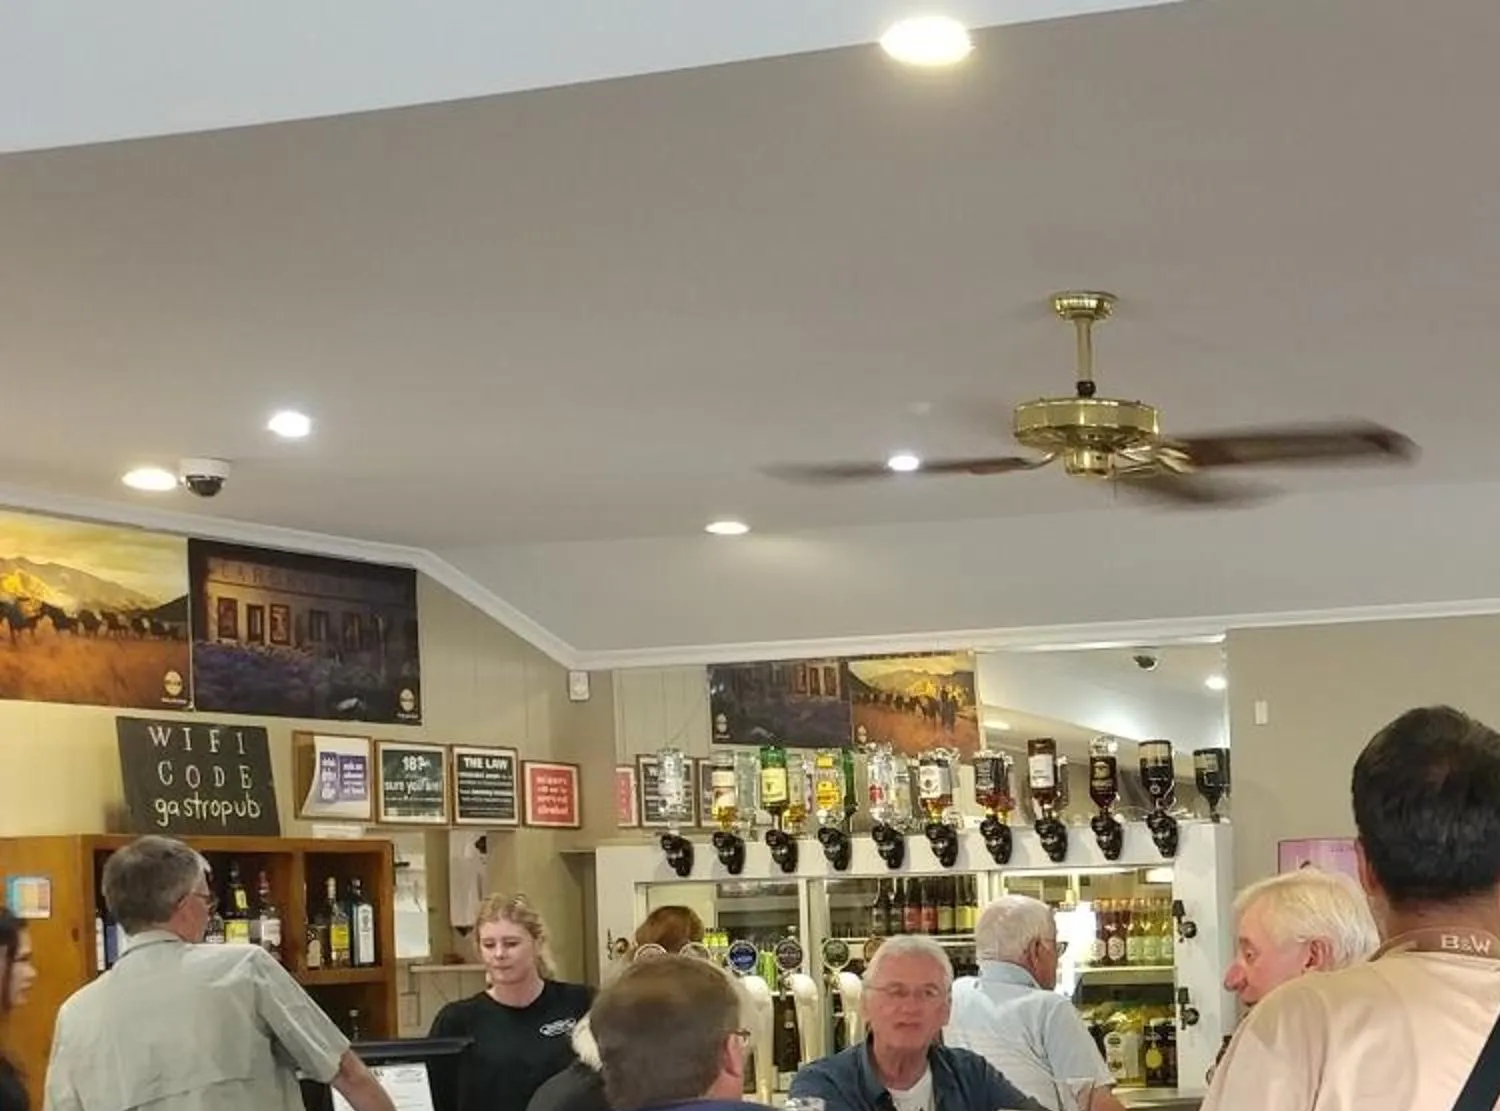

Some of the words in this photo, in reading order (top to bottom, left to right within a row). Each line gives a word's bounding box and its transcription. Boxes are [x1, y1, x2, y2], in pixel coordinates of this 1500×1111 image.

[464, 757, 485, 769] THE
[485, 758, 509, 771] LAW
[154, 791, 261, 827] gastropub
